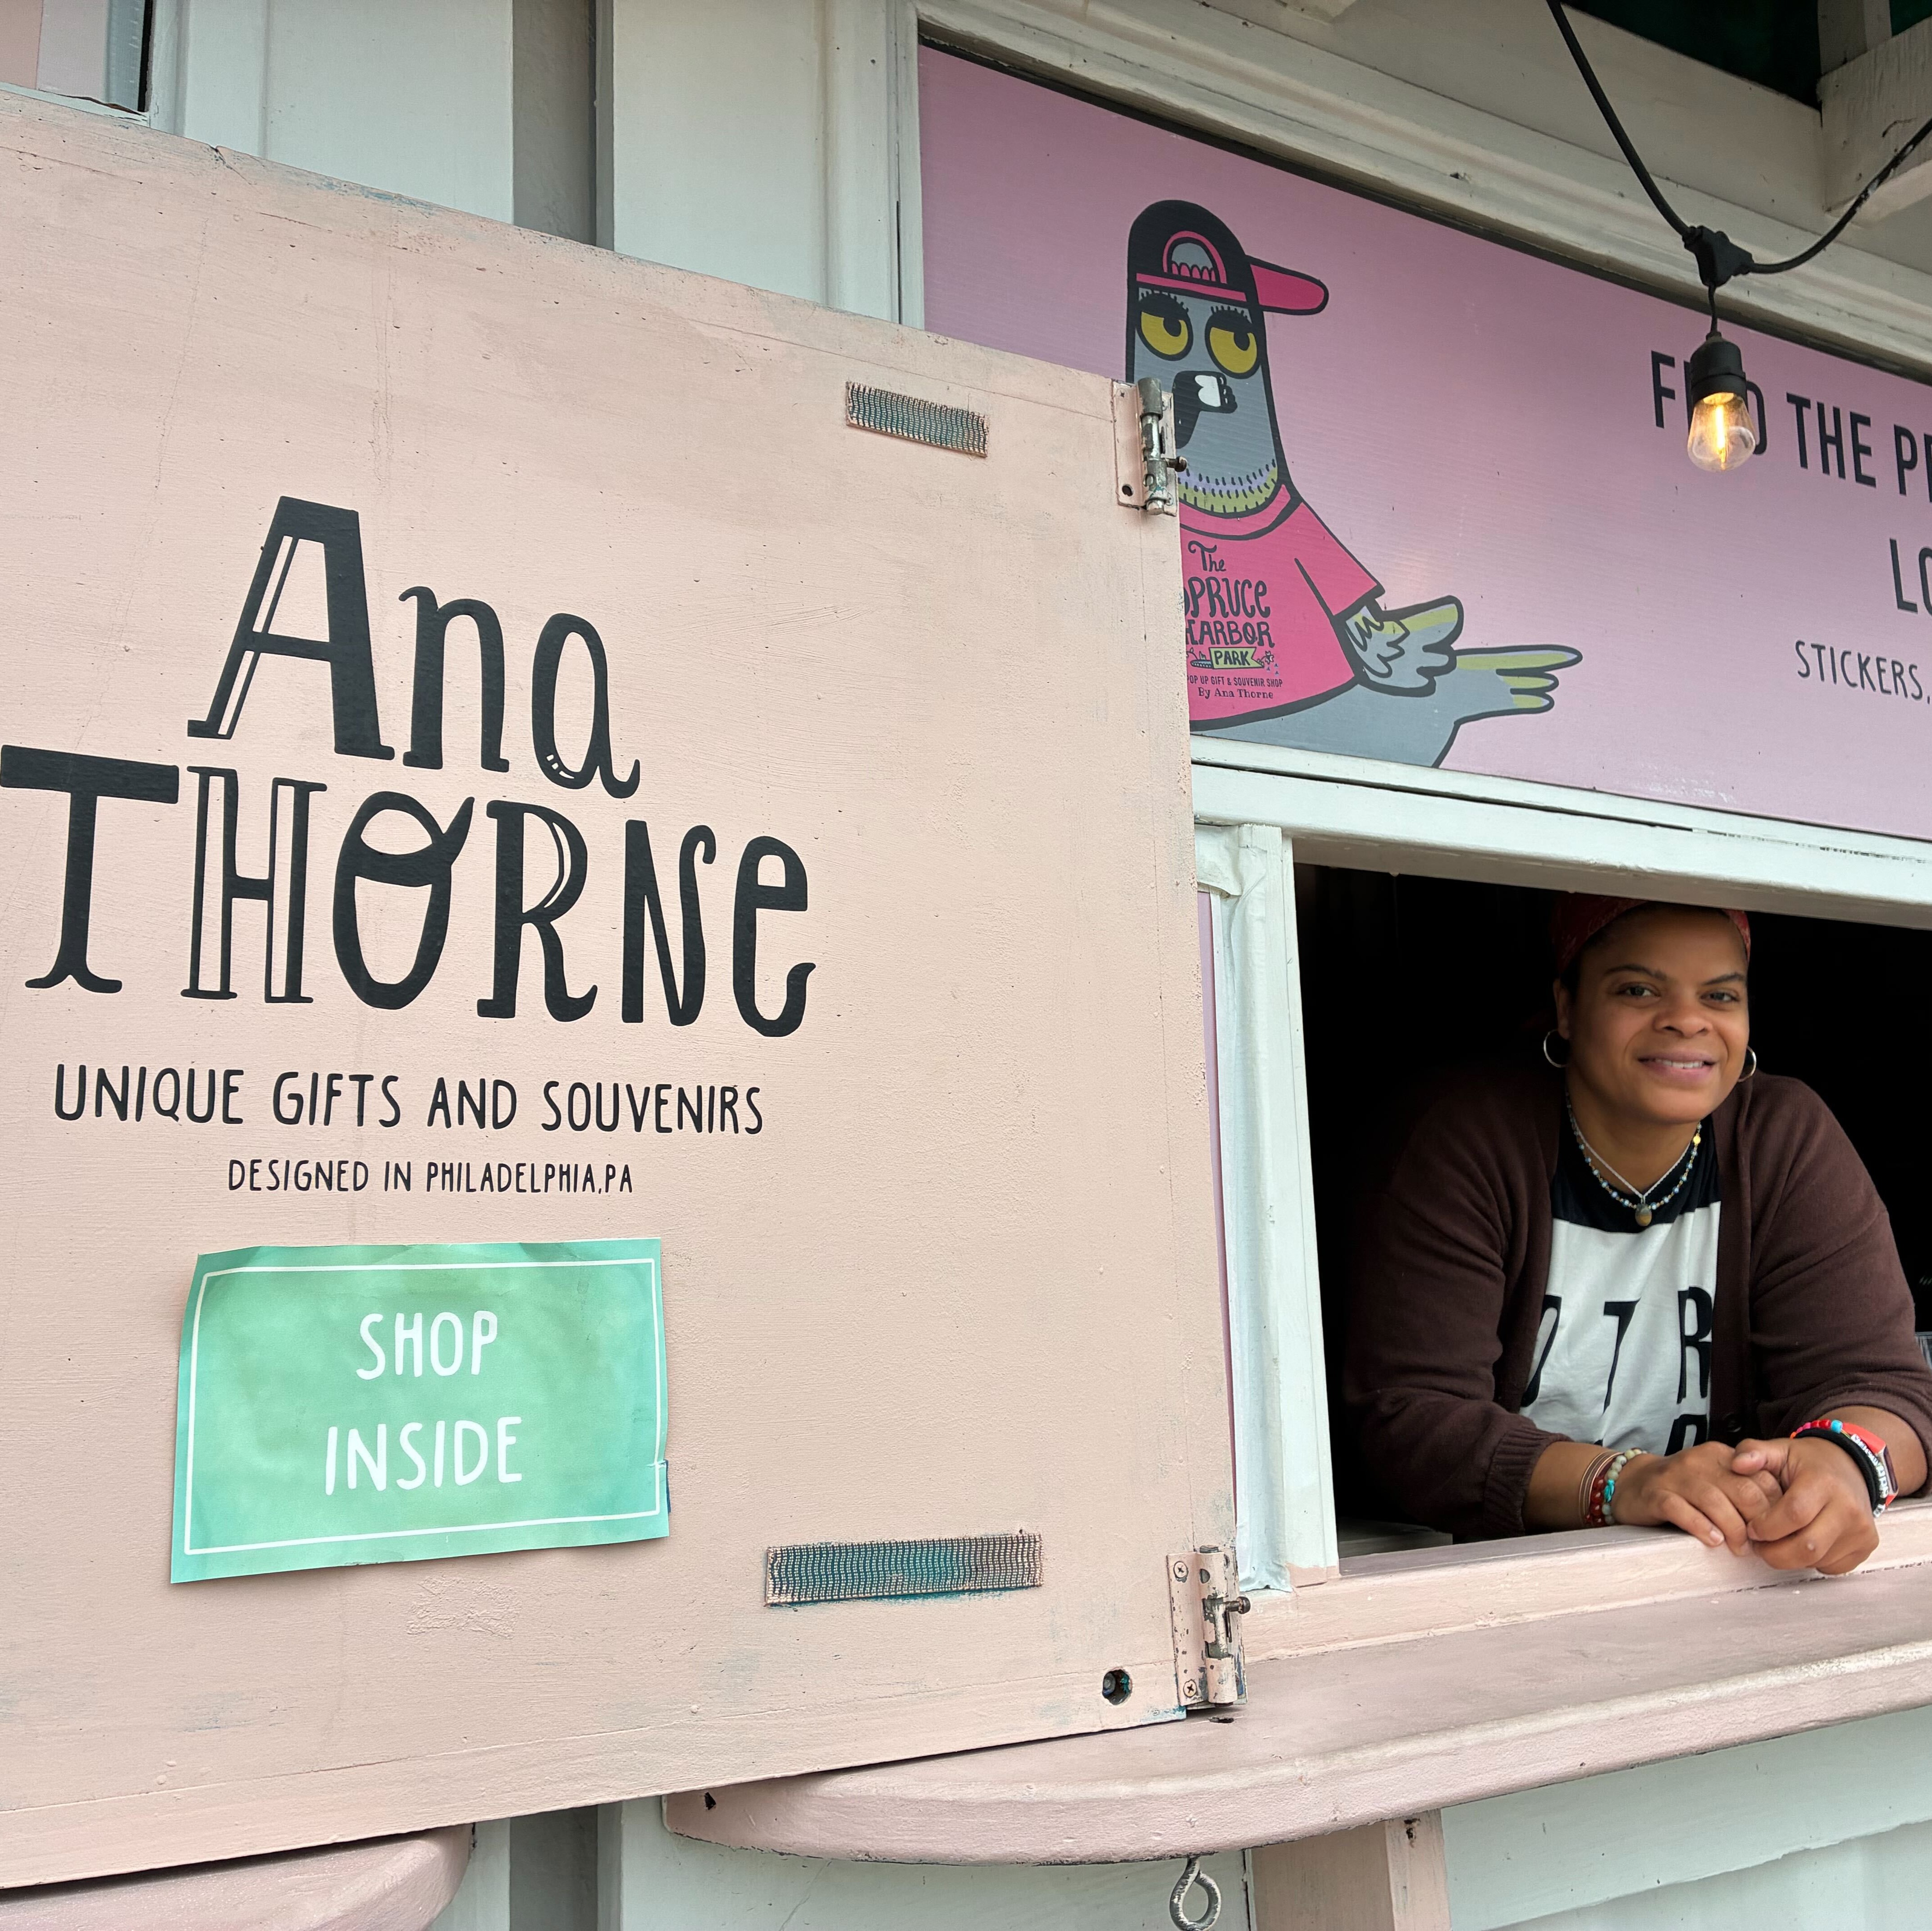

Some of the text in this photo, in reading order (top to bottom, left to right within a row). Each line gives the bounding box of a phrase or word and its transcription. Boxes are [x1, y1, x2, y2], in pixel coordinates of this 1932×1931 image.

[1651, 350, 1767, 455] FID
[1786, 392, 1877, 488] THE
[1188, 540, 1227, 572] The
[187, 496, 640, 799] Ana
[1214, 650, 1251, 666] PARK
[1795, 640, 1931, 705] STICKERS,
[1198, 686, 1273, 699] By Ana Thorne
[1200, 675, 1209, 685] UP
[1210, 676, 1224, 685] GIFT
[1227, 677, 1232, 686] &
[1233, 677, 1265, 687] SOUVENIR
[1266, 678, 1283, 687] SHOP
[55, 1064, 763, 1135] UNIQUE GIFTS AND SOUVENIRS
[228, 1159, 369, 1192] DESIGNED
[384, 1161, 411, 1192] IN
[356, 1310, 498, 1380] SHOP
[325, 1416, 522, 1496] INSIDE
